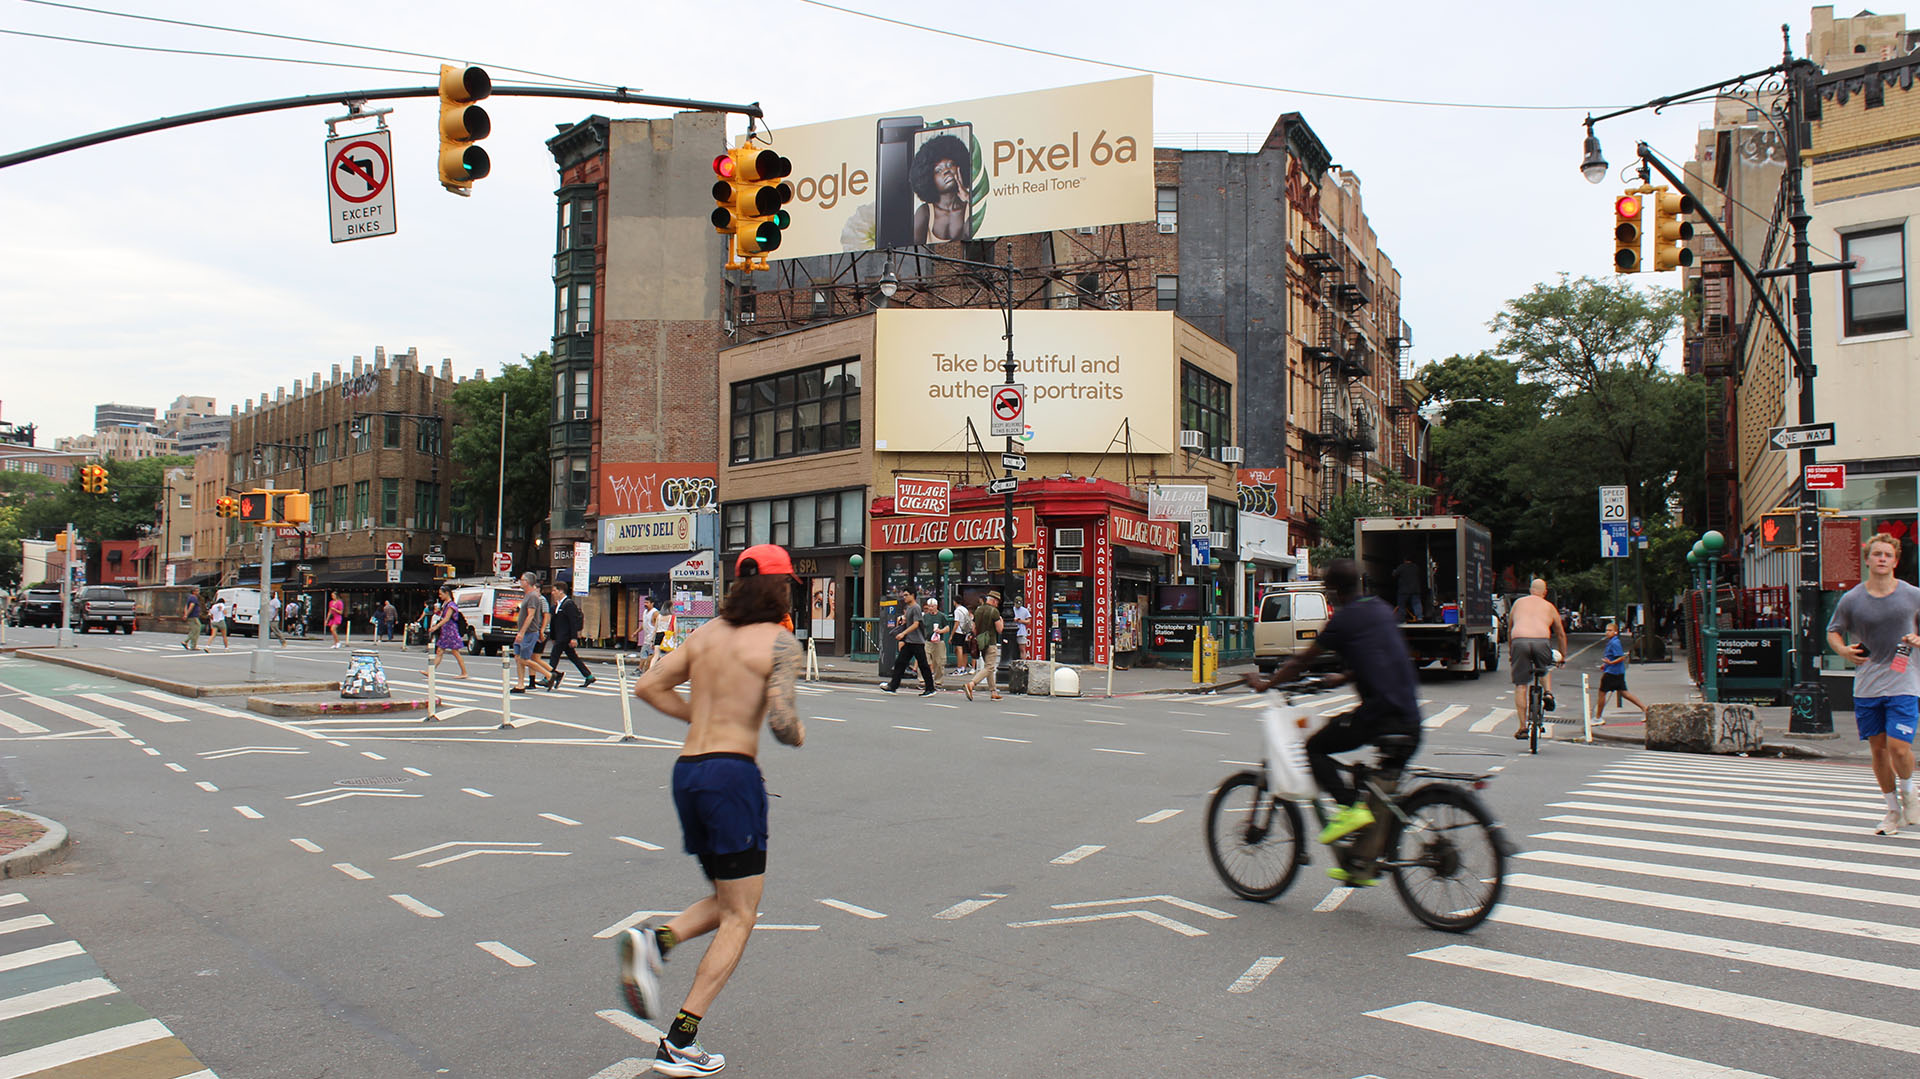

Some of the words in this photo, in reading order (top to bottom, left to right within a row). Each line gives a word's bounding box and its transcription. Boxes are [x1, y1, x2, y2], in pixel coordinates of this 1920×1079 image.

[993, 131, 1079, 177] Pixel
[1090, 129, 1137, 166] 6a
[993, 183, 1020, 197] with
[1022, 179, 1048, 194] Real
[342, 205, 383, 221] EXCEPT
[347, 220, 380, 235] BIKES
[932, 353, 978, 373] Take
[1081, 354, 1120, 374] and
[1033, 381, 1124, 404] portraits
[1779, 432, 1797, 444] ONE
[1805, 430, 1827, 441] WAY
[899, 484, 947, 497] VILLAGE
[900, 497, 946, 512] CIGARS
[1604, 504, 1625, 518] 20
[619, 523, 651, 539] ANDY'S
[653, 521, 674, 537] DELI
[882, 521, 950, 545] VILLAGE
[1114, 516, 1149, 544] VILLAGE
[1193, 524, 1208, 535] 20
[686, 560, 704, 568] ATM
[800, 559, 817, 573] SPA
[1154, 623, 1186, 631] Christopher
[1761, 639, 1771, 648] St
